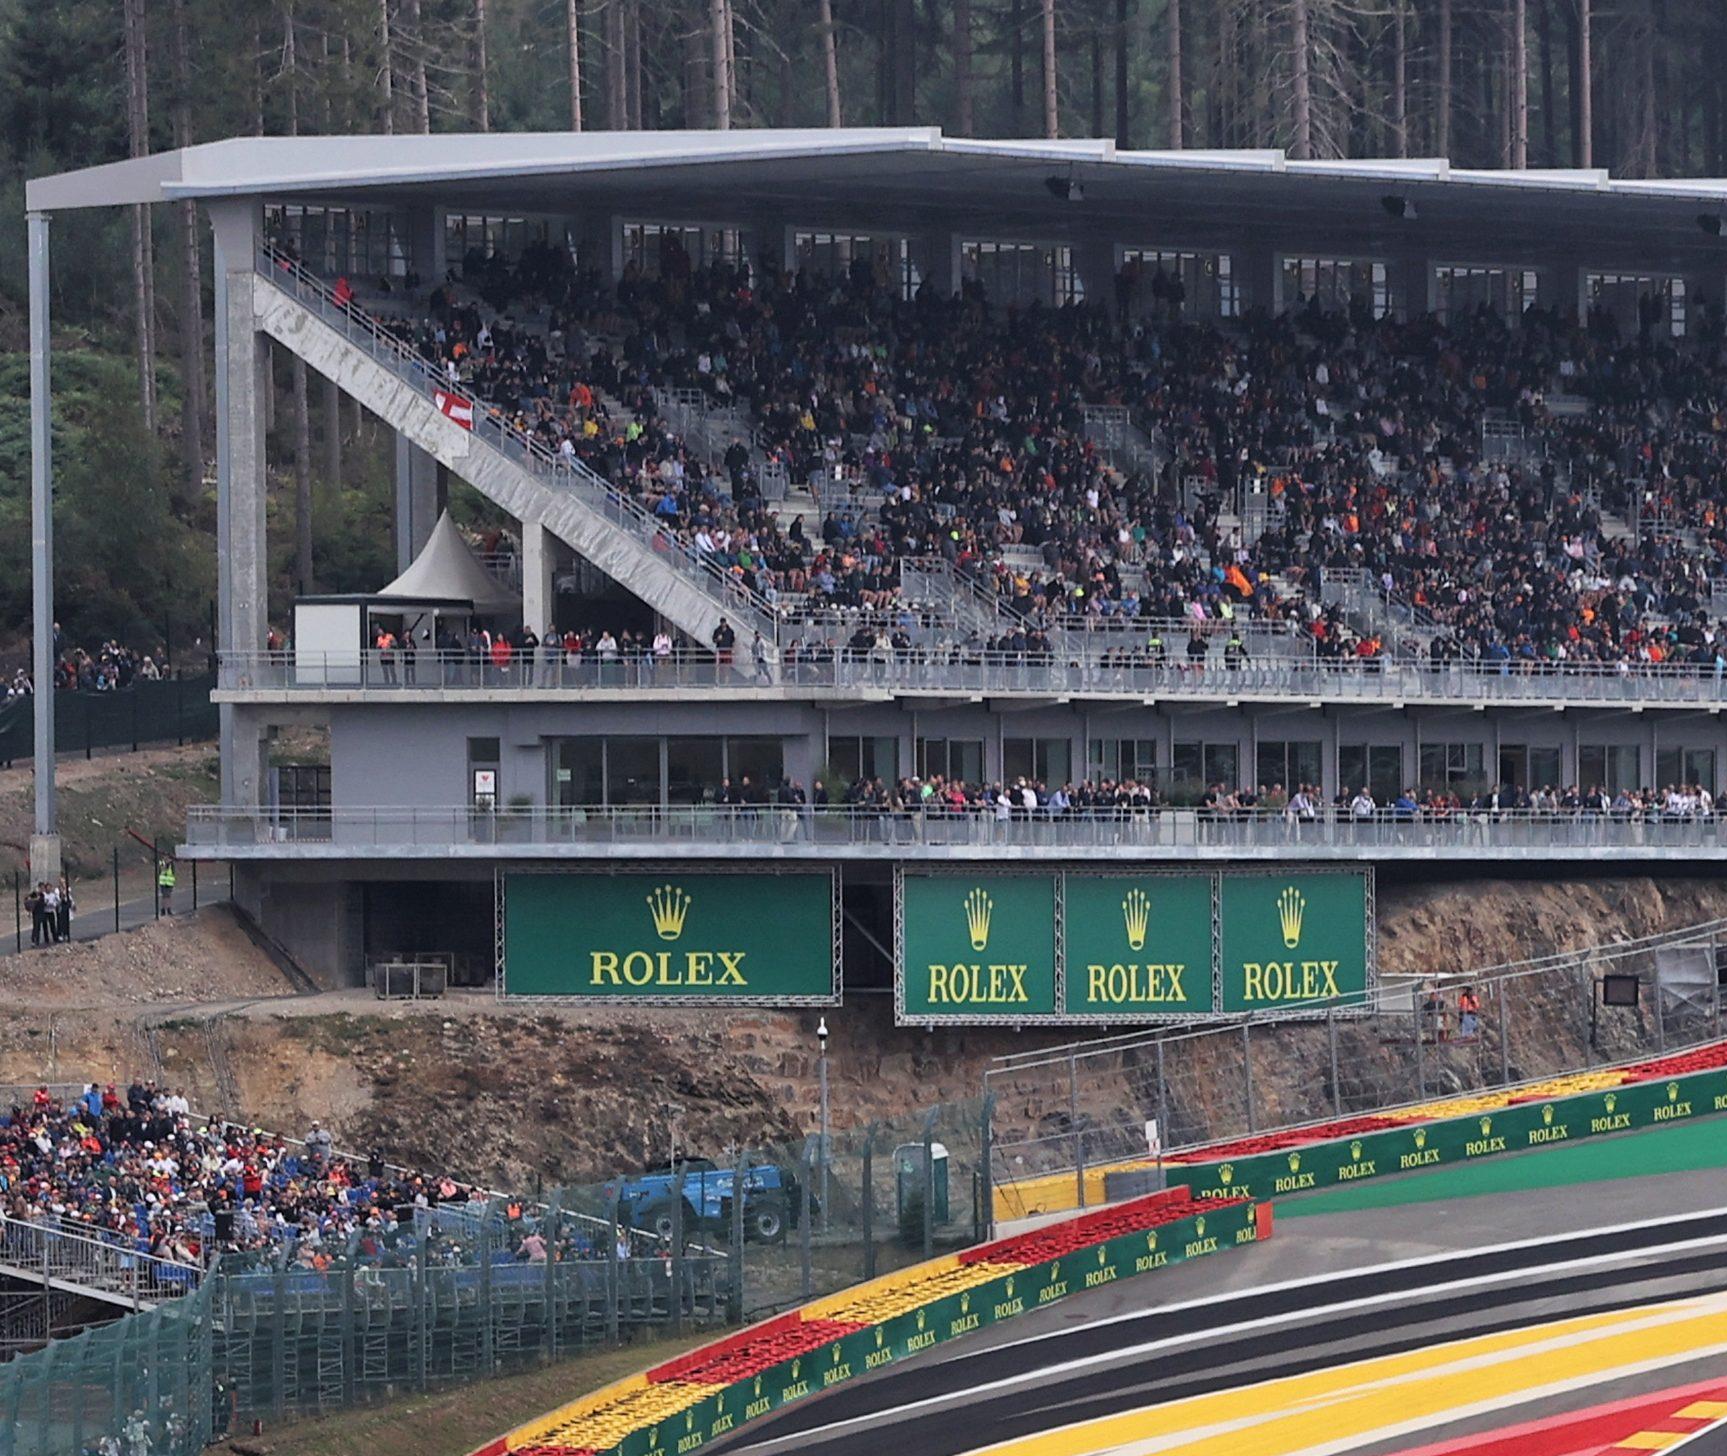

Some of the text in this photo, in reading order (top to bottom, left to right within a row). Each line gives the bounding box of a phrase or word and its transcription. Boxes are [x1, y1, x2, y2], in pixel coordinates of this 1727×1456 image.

[589, 951, 748, 985] ROLEX
[927, 964, 1029, 1003] ROLEX
[1087, 964, 1187, 1003] ROLEX
[1243, 961, 1341, 1001] ROLEX
[1654, 1101, 1692, 1120] ROLEX
[1591, 1113, 1631, 1132] ROLEX
[1529, 1125, 1568, 1144] ROLEX
[1466, 1137, 1506, 1156] ROLEX
[1400, 1148, 1440, 1168] ROLEX
[1339, 1161, 1375, 1180] ROLEX
[1275, 1172, 1315, 1192] ROLEX
[1185, 1237, 1218, 1258] ROLEX
[1136, 1251, 1167, 1271] ROLEX
[1086, 1265, 1117, 1286] ROLEX
[1039, 1281, 1067, 1302] ROLEX
[994, 1297, 1023, 1318] ROLEX
[951, 1313, 979, 1335] ROLEX
[908, 1330, 935, 1351] ROLEX
[865, 1347, 892, 1369] ROLEX
[823, 1363, 851, 1386] ROLEX
[783, 1381, 809, 1402] ROLEX
[746, 1397, 770, 1419] ROLEX
